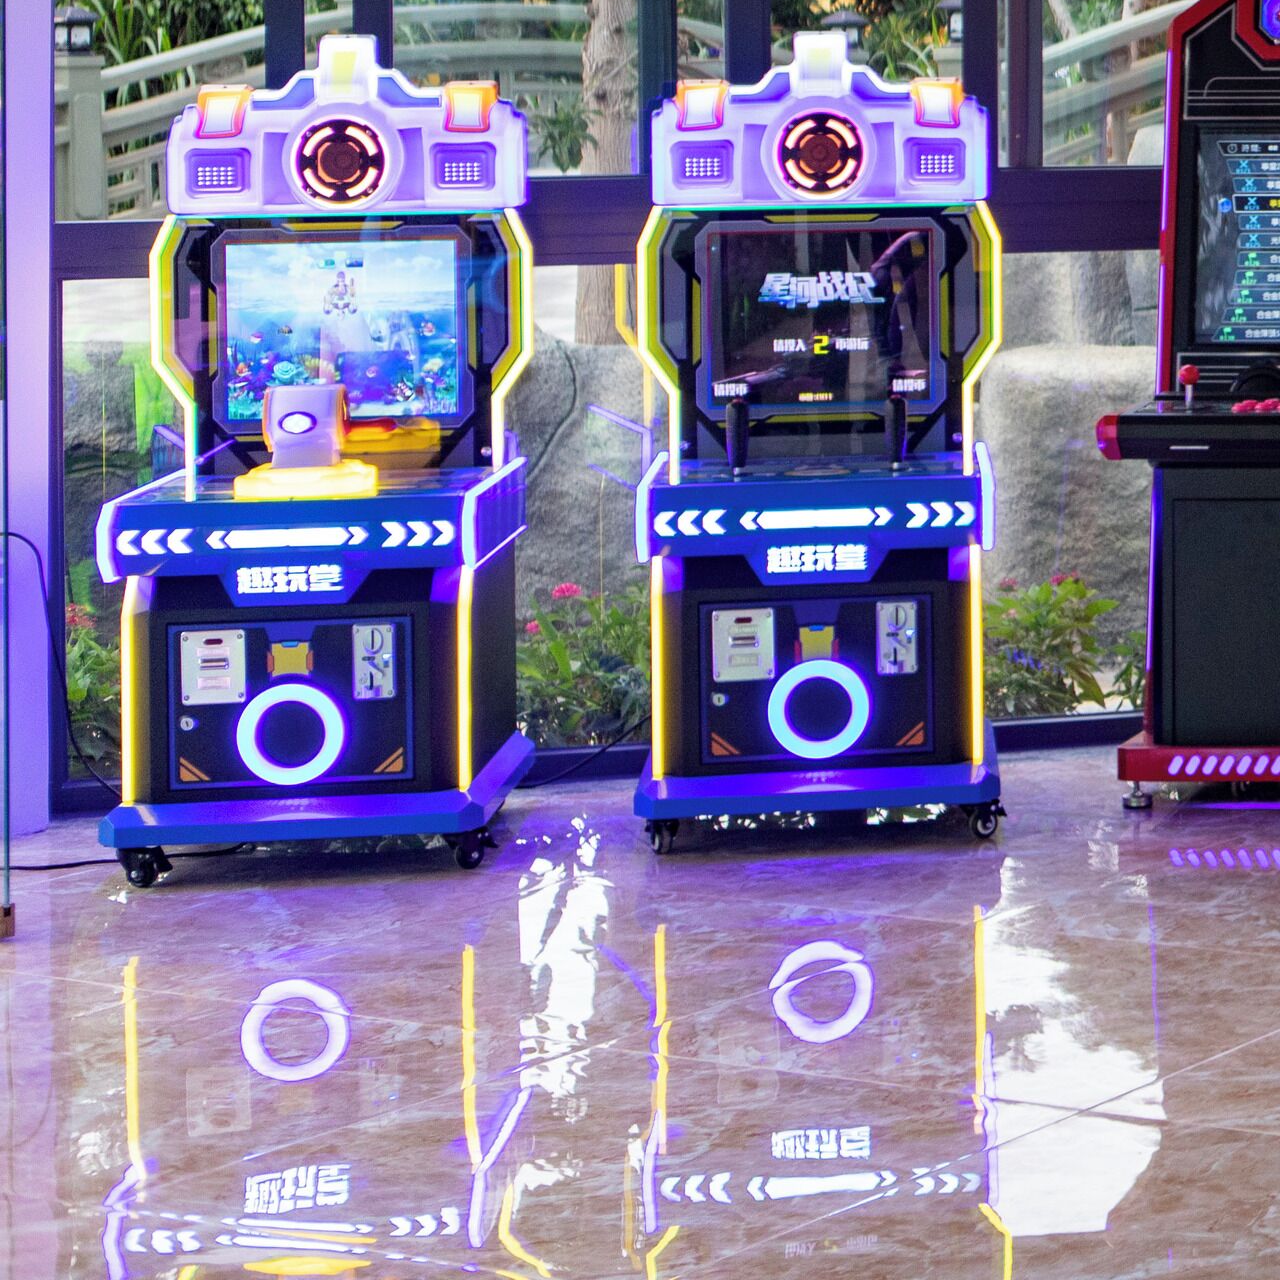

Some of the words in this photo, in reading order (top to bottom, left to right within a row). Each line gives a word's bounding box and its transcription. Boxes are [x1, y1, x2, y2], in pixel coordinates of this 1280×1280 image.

[813, 335, 830, 354] 2
[767, 544, 867, 573] 趣玩堂
[237, 564, 344, 594] 趣玩堂
